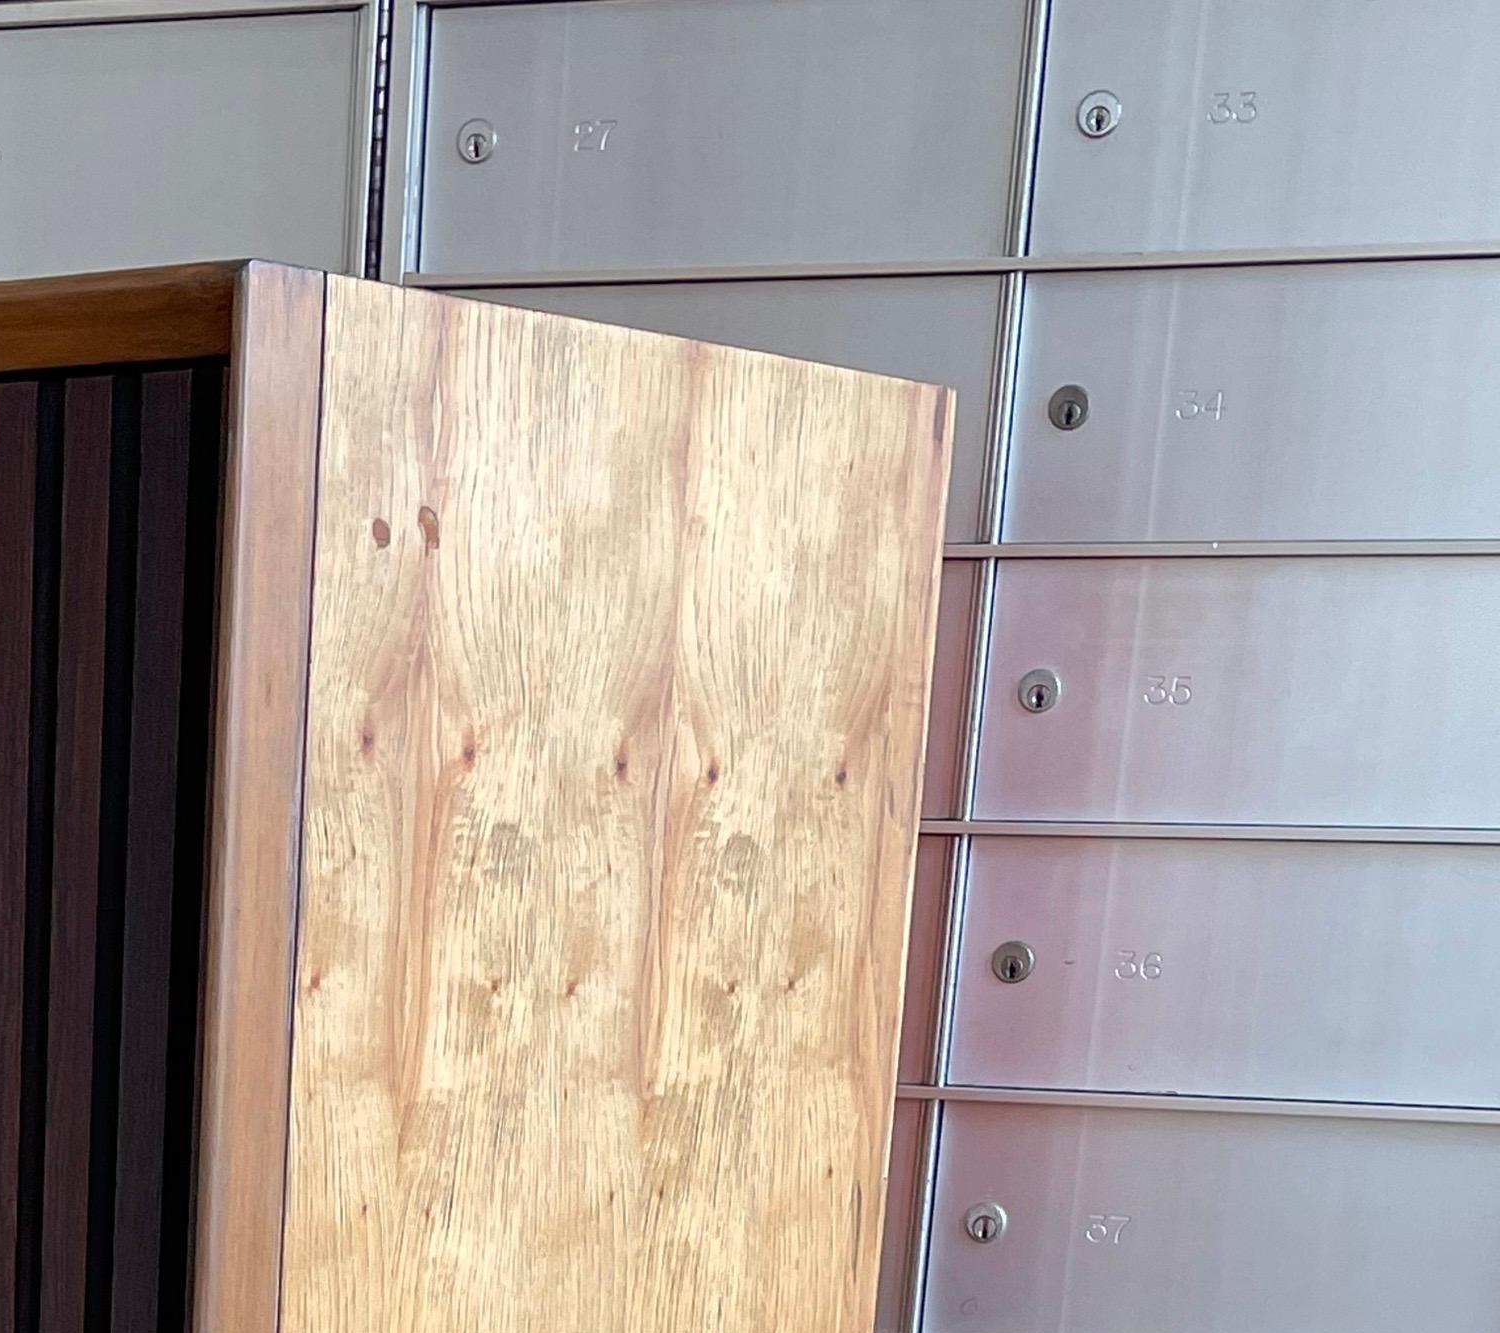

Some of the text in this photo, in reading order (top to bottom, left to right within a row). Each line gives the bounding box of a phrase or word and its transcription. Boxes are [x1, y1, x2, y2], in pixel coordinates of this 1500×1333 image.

[1206, 91, 1257, 124] 33
[574, 119, 618, 152] 27
[1175, 389, 1227, 420] 34
[1143, 675, 1192, 705] 35
[1114, 950, 1164, 981] 36
[1085, 1213, 1132, 1244] 37
